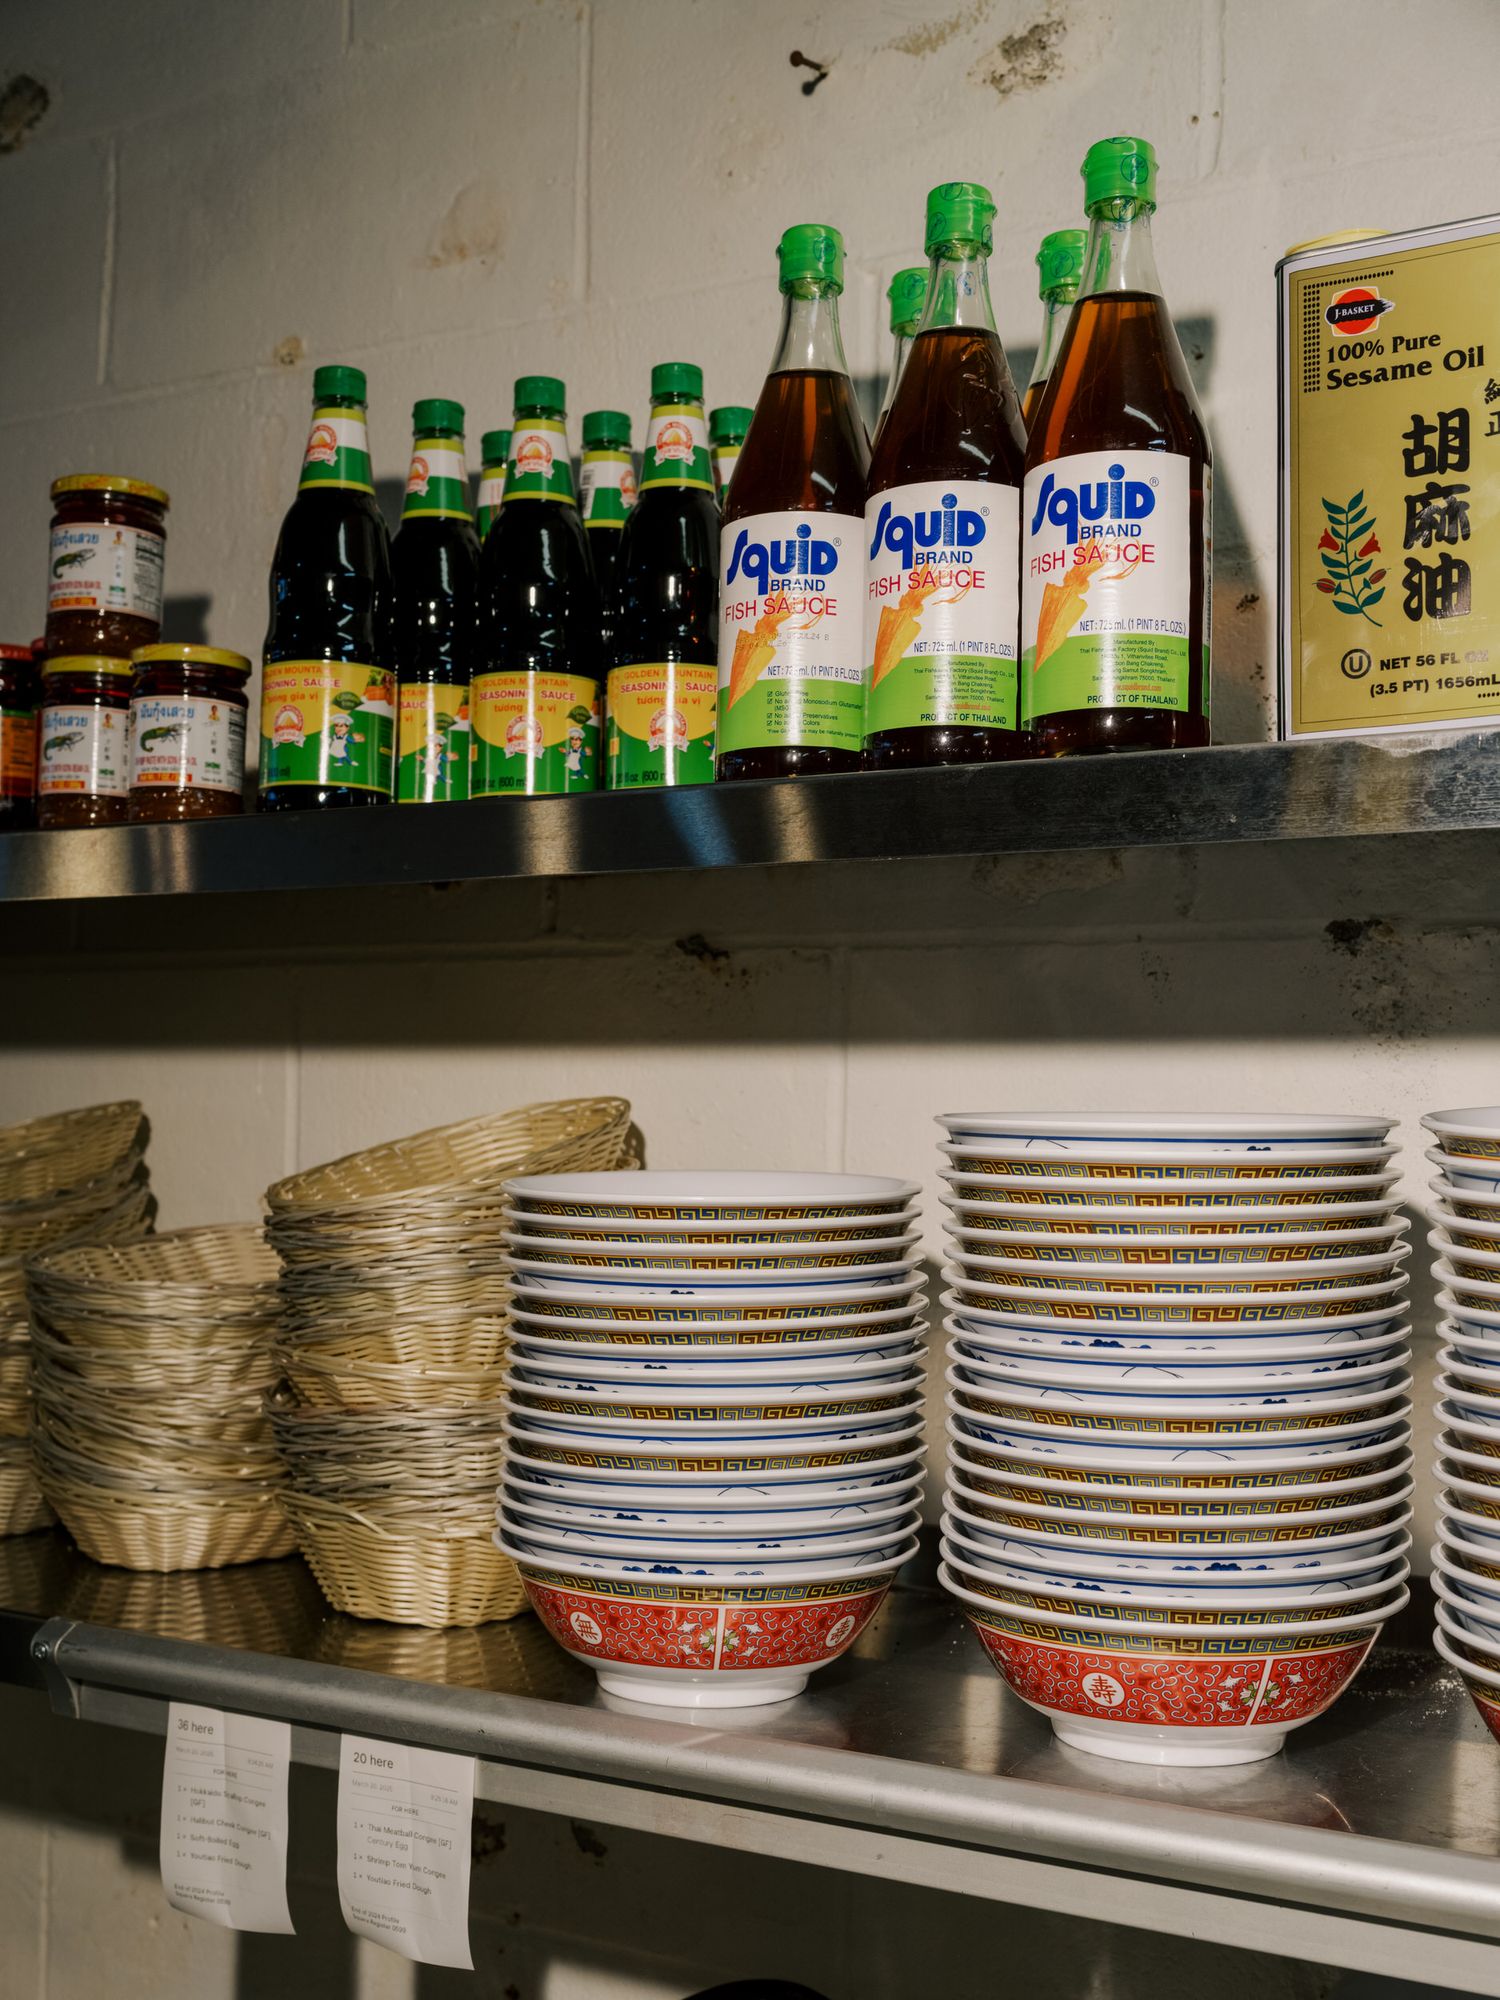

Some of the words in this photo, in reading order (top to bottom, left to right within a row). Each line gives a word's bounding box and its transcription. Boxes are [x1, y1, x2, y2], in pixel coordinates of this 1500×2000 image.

[1334, 303, 1376, 320] J-BASKET
[1327, 339, 1385, 363] 100%
[1391, 334, 1441, 354] Pure
[1327, 360, 1433, 390] Sesame
[1442, 345, 1484, 372] Oil
[1401, 408, 1472, 623] 胡麻油
[1080, 523, 1142, 540] BRAND
[915, 551, 973, 565] BRAND
[1031, 549, 1066, 578] FISH
[1073, 543, 1156, 566] SAUCE
[771, 579, 826, 592] BRAND
[869, 574, 901, 600] FISH
[908, 569, 985, 589] SAUCE
[725, 599, 757, 624] FISH
[763, 597, 838, 616] SAUCE
[1136, 618, 1153, 630] PINT
[1154, 620, 1159, 631] 8
[967, 641, 983, 652] PINT
[984, 643, 989, 653] 8
[1380, 656, 1410, 671] NET
[1416, 654, 1436, 667] 56
[1440, 653, 1460, 665] FL
[624, 670, 659, 680] GOLDEN
[818, 665, 834, 677] PINT
[835, 667, 839, 678] 8
[482, 679, 515, 688] GOLDEN
[1370, 682, 1398, 698] (3.5
[1403, 679, 1429, 693] PT)
[1436, 673, 1500, 690] 1656mL
[479, 689, 529, 702] SEASONIN
[540, 689, 576, 702] SAUCE
[1087, 694, 1127, 703] PROCT
[1128, 694, 1140, 703] OF
[1141, 694, 1178, 706] THAILAND
[921, 712, 958, 722] PROCT
[959, 713, 971, 721] OF
[972, 713, 1007, 724] THAILAND
[575, 1614, 598, 1641] 無
[1088, 1675, 1117, 1704] 壽
[177, 1718, 189, 1731] 36
[191, 1722, 214, 1735] here
[353, 1751, 367, 1764] 20
[369, 1754, 394, 1769] here
[391, 1805, 403, 1813] FOR
[404, 1807, 419, 1816] HERE
[367, 1836, 393, 1849] Century
[395, 1840, 408, 1852] Egg
[383, 1826, 413, 1837] Meatball
[438, 1838, 452, 1850] [GF]
[367, 1855, 390, 1867] Shrimp
[392, 1860, 407, 1869] Tom
[409, 1863, 421, 1872] Yum
[423, 1866, 447, 1880] Congee
[392, 1879, 411, 1889] Fried
[412, 1882, 432, 1895] Dough
